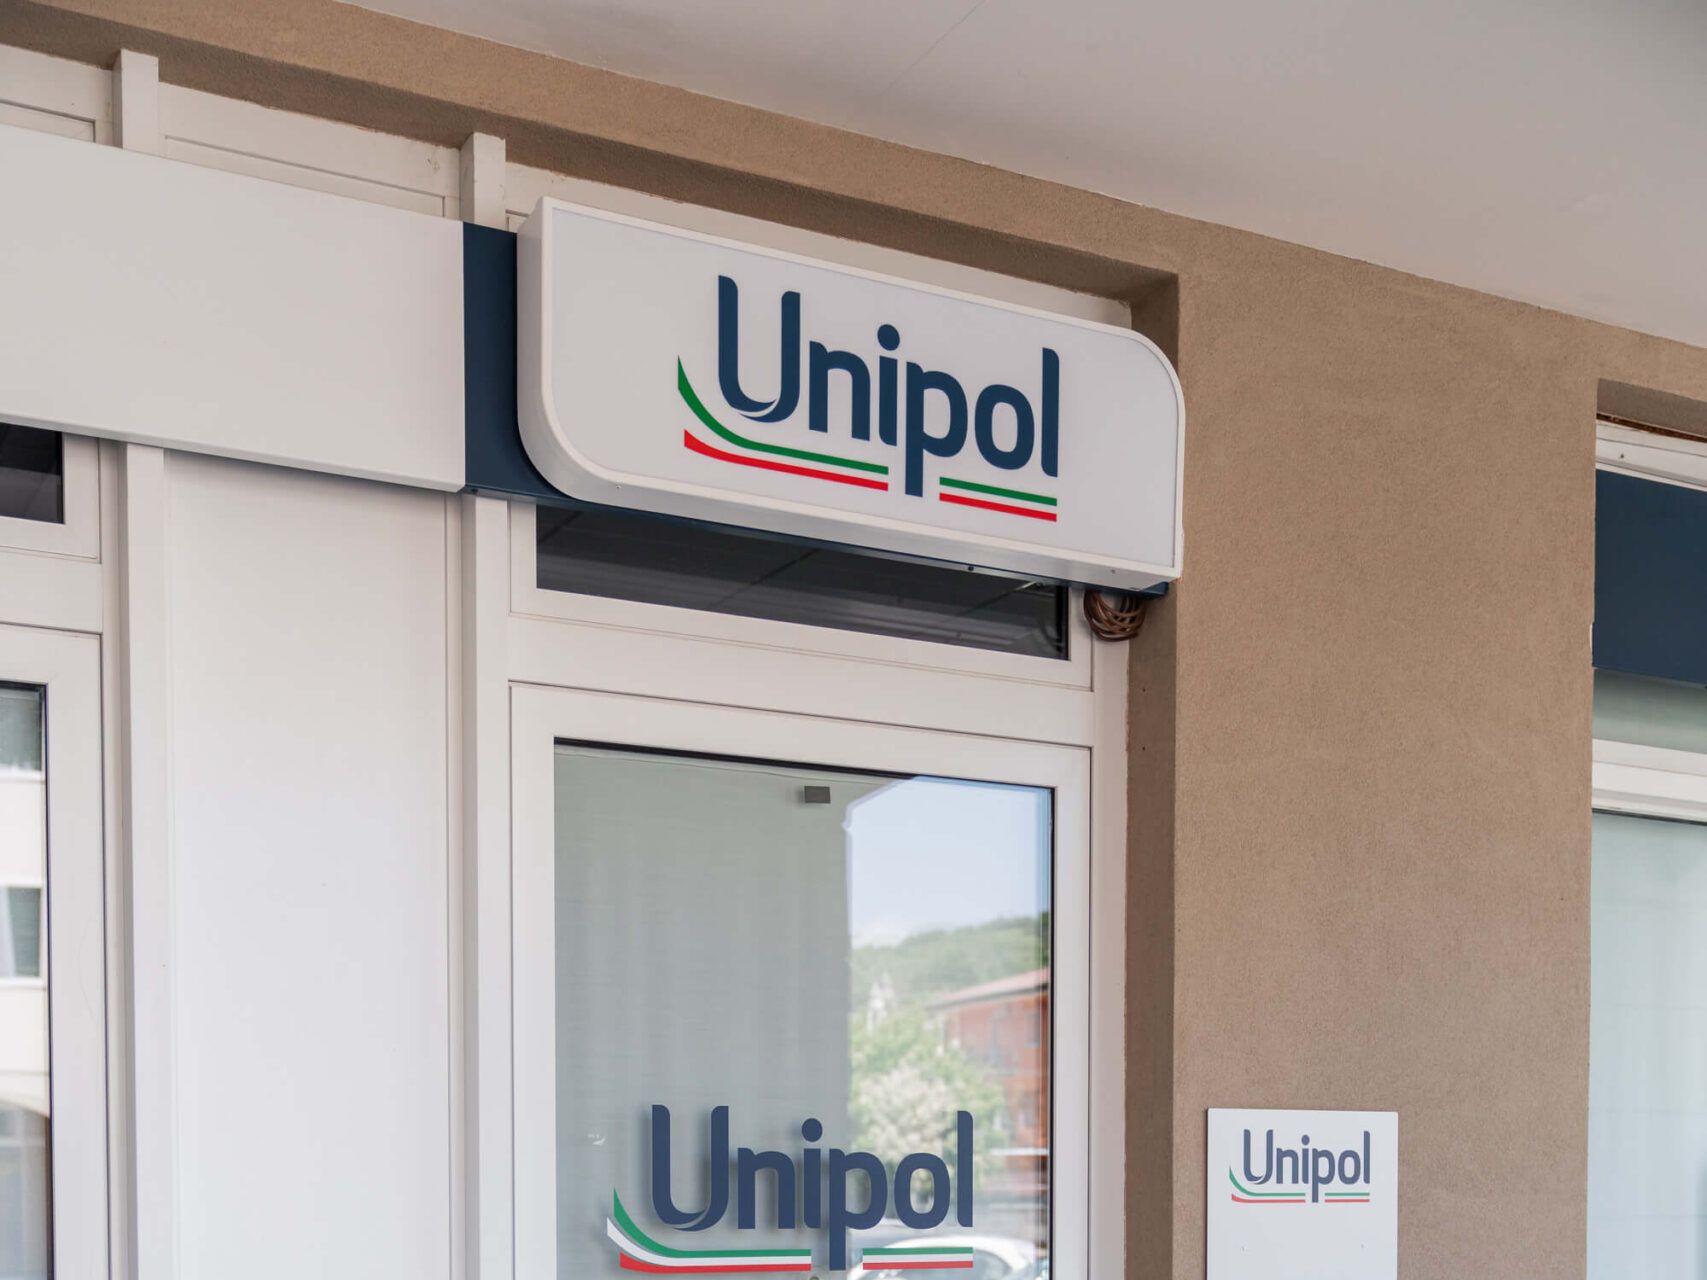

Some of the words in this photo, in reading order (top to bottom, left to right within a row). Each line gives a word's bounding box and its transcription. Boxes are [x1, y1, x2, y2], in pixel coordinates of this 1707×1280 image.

[718, 275, 1060, 497] Unipol
[652, 1104, 974, 1271] Unipol
[1243, 1129, 1371, 1203] Unipol
